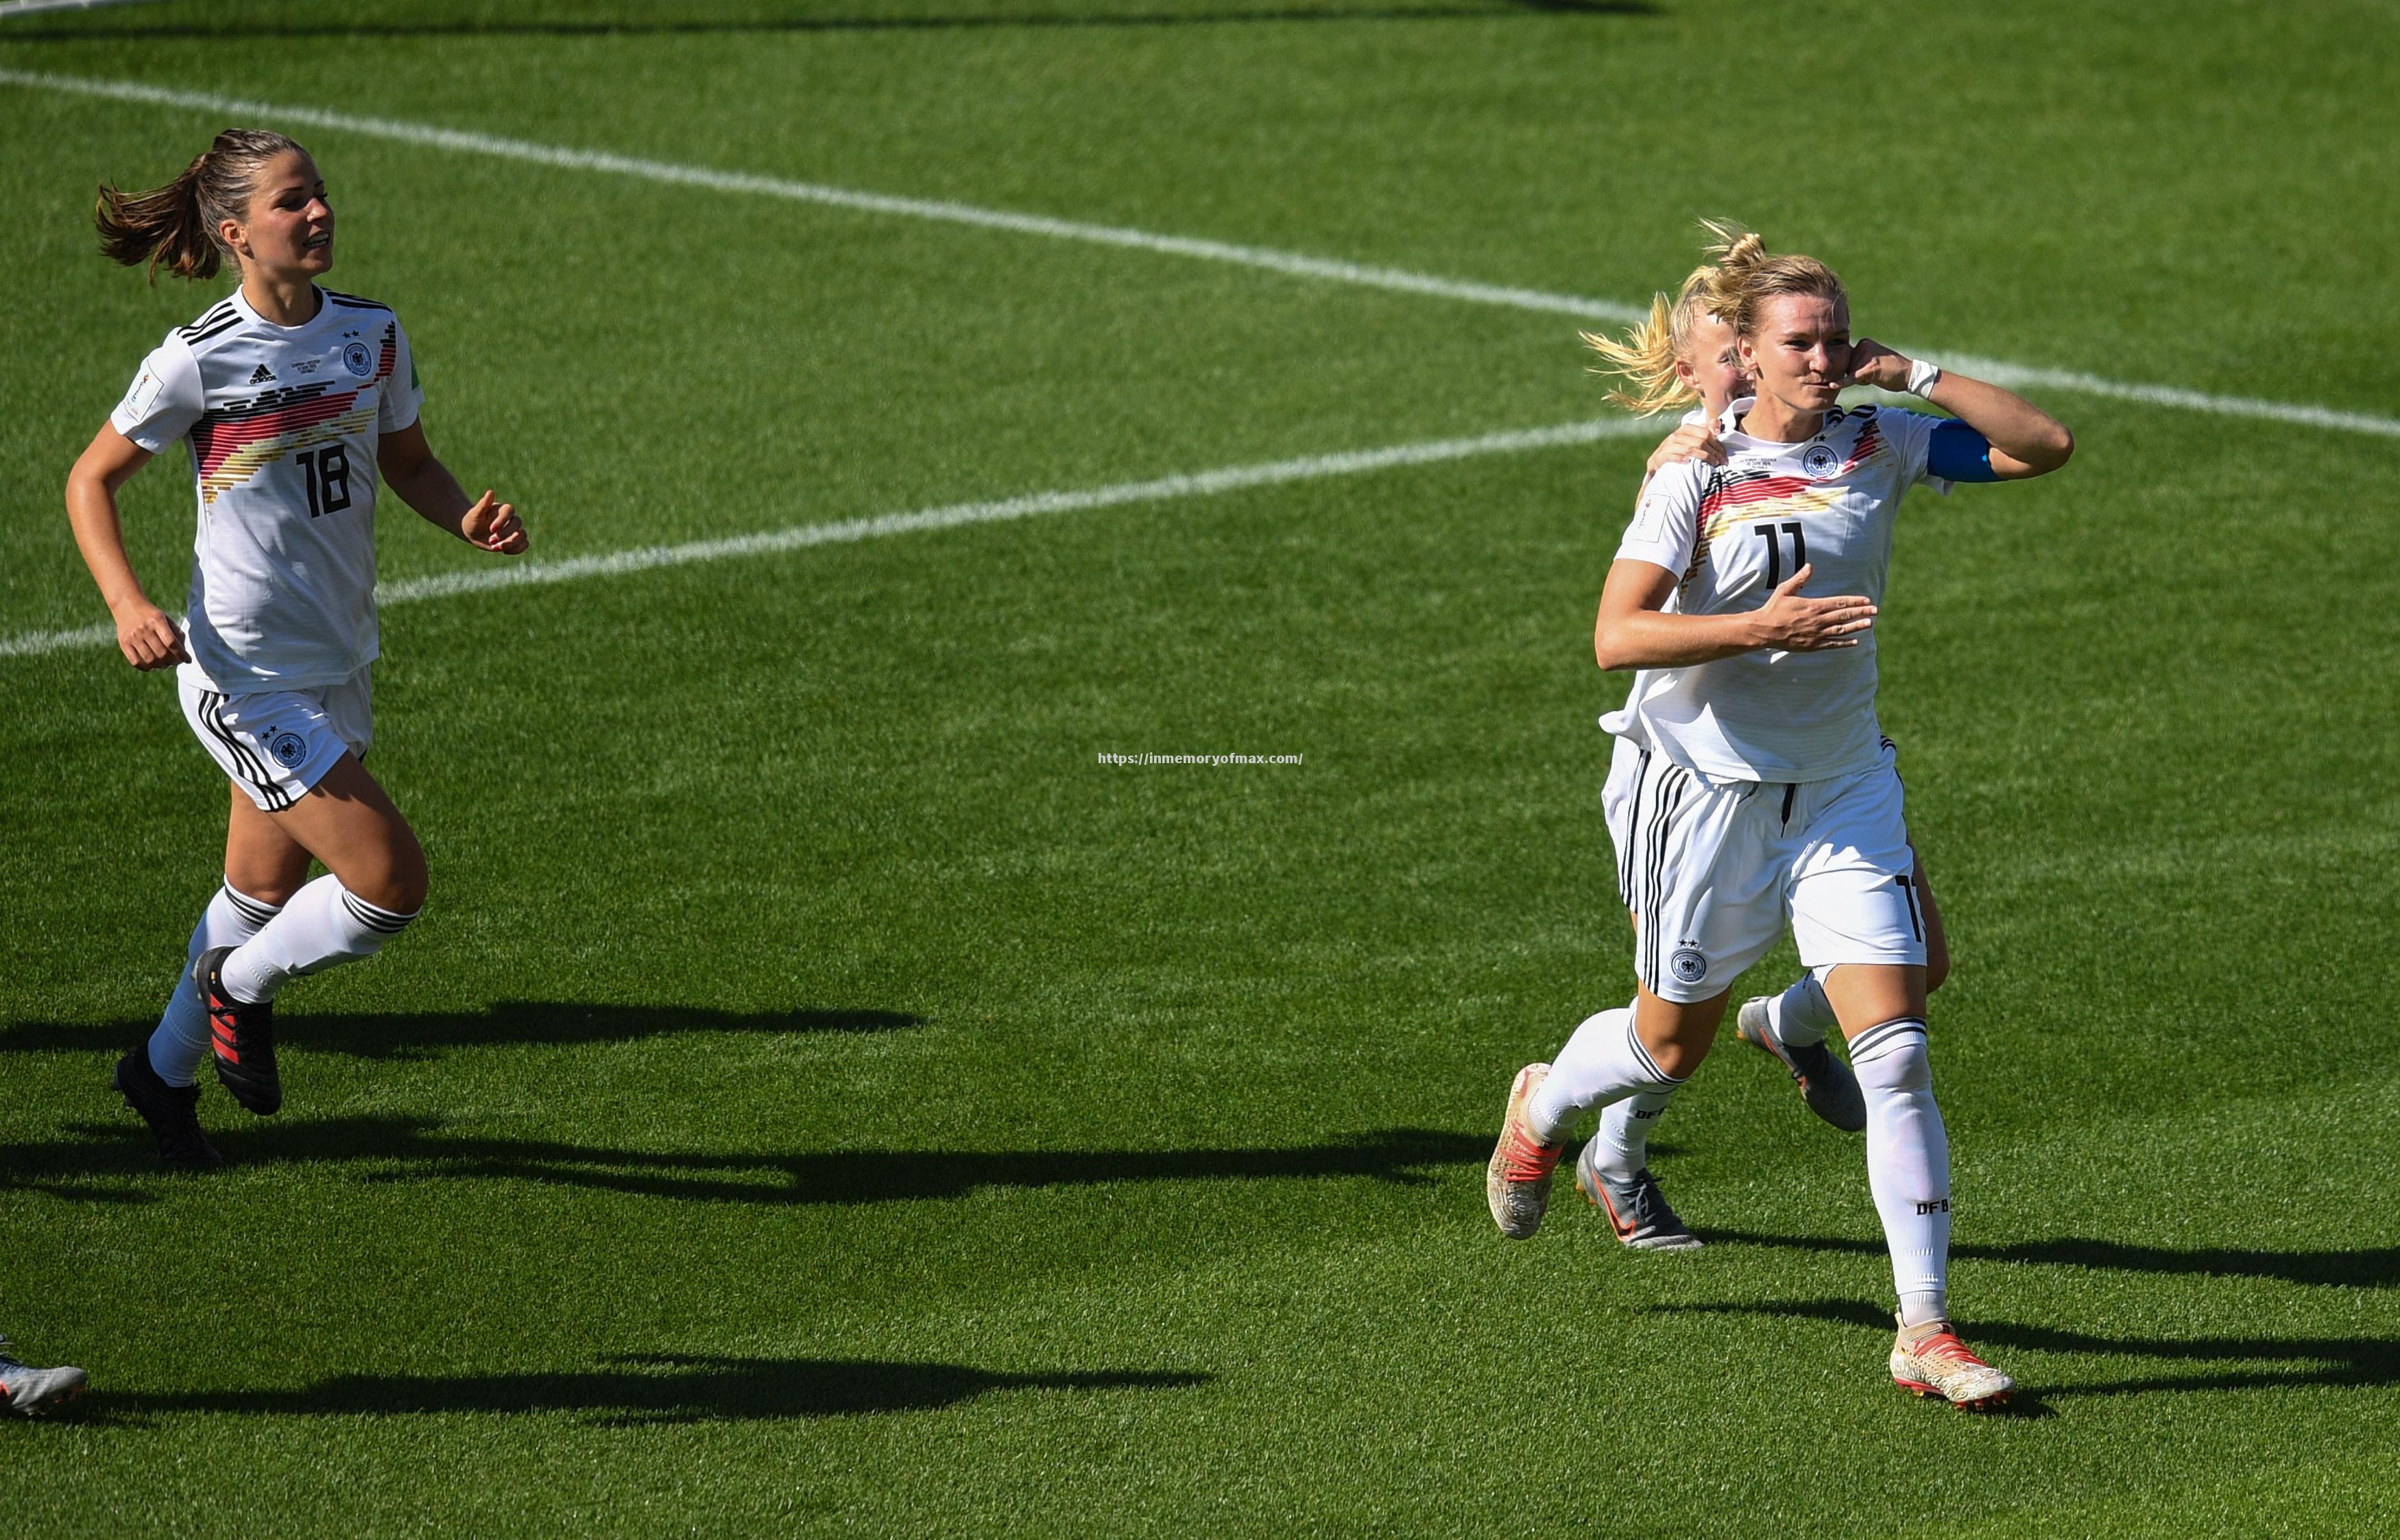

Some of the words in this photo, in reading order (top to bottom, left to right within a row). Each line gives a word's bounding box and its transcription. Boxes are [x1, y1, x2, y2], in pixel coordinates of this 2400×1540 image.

[250, 375, 277, 385] adidas
[296, 444, 351, 518] 18
[1754, 522, 1806, 590] 11
[1917, 1199, 1949, 1215] DFB
